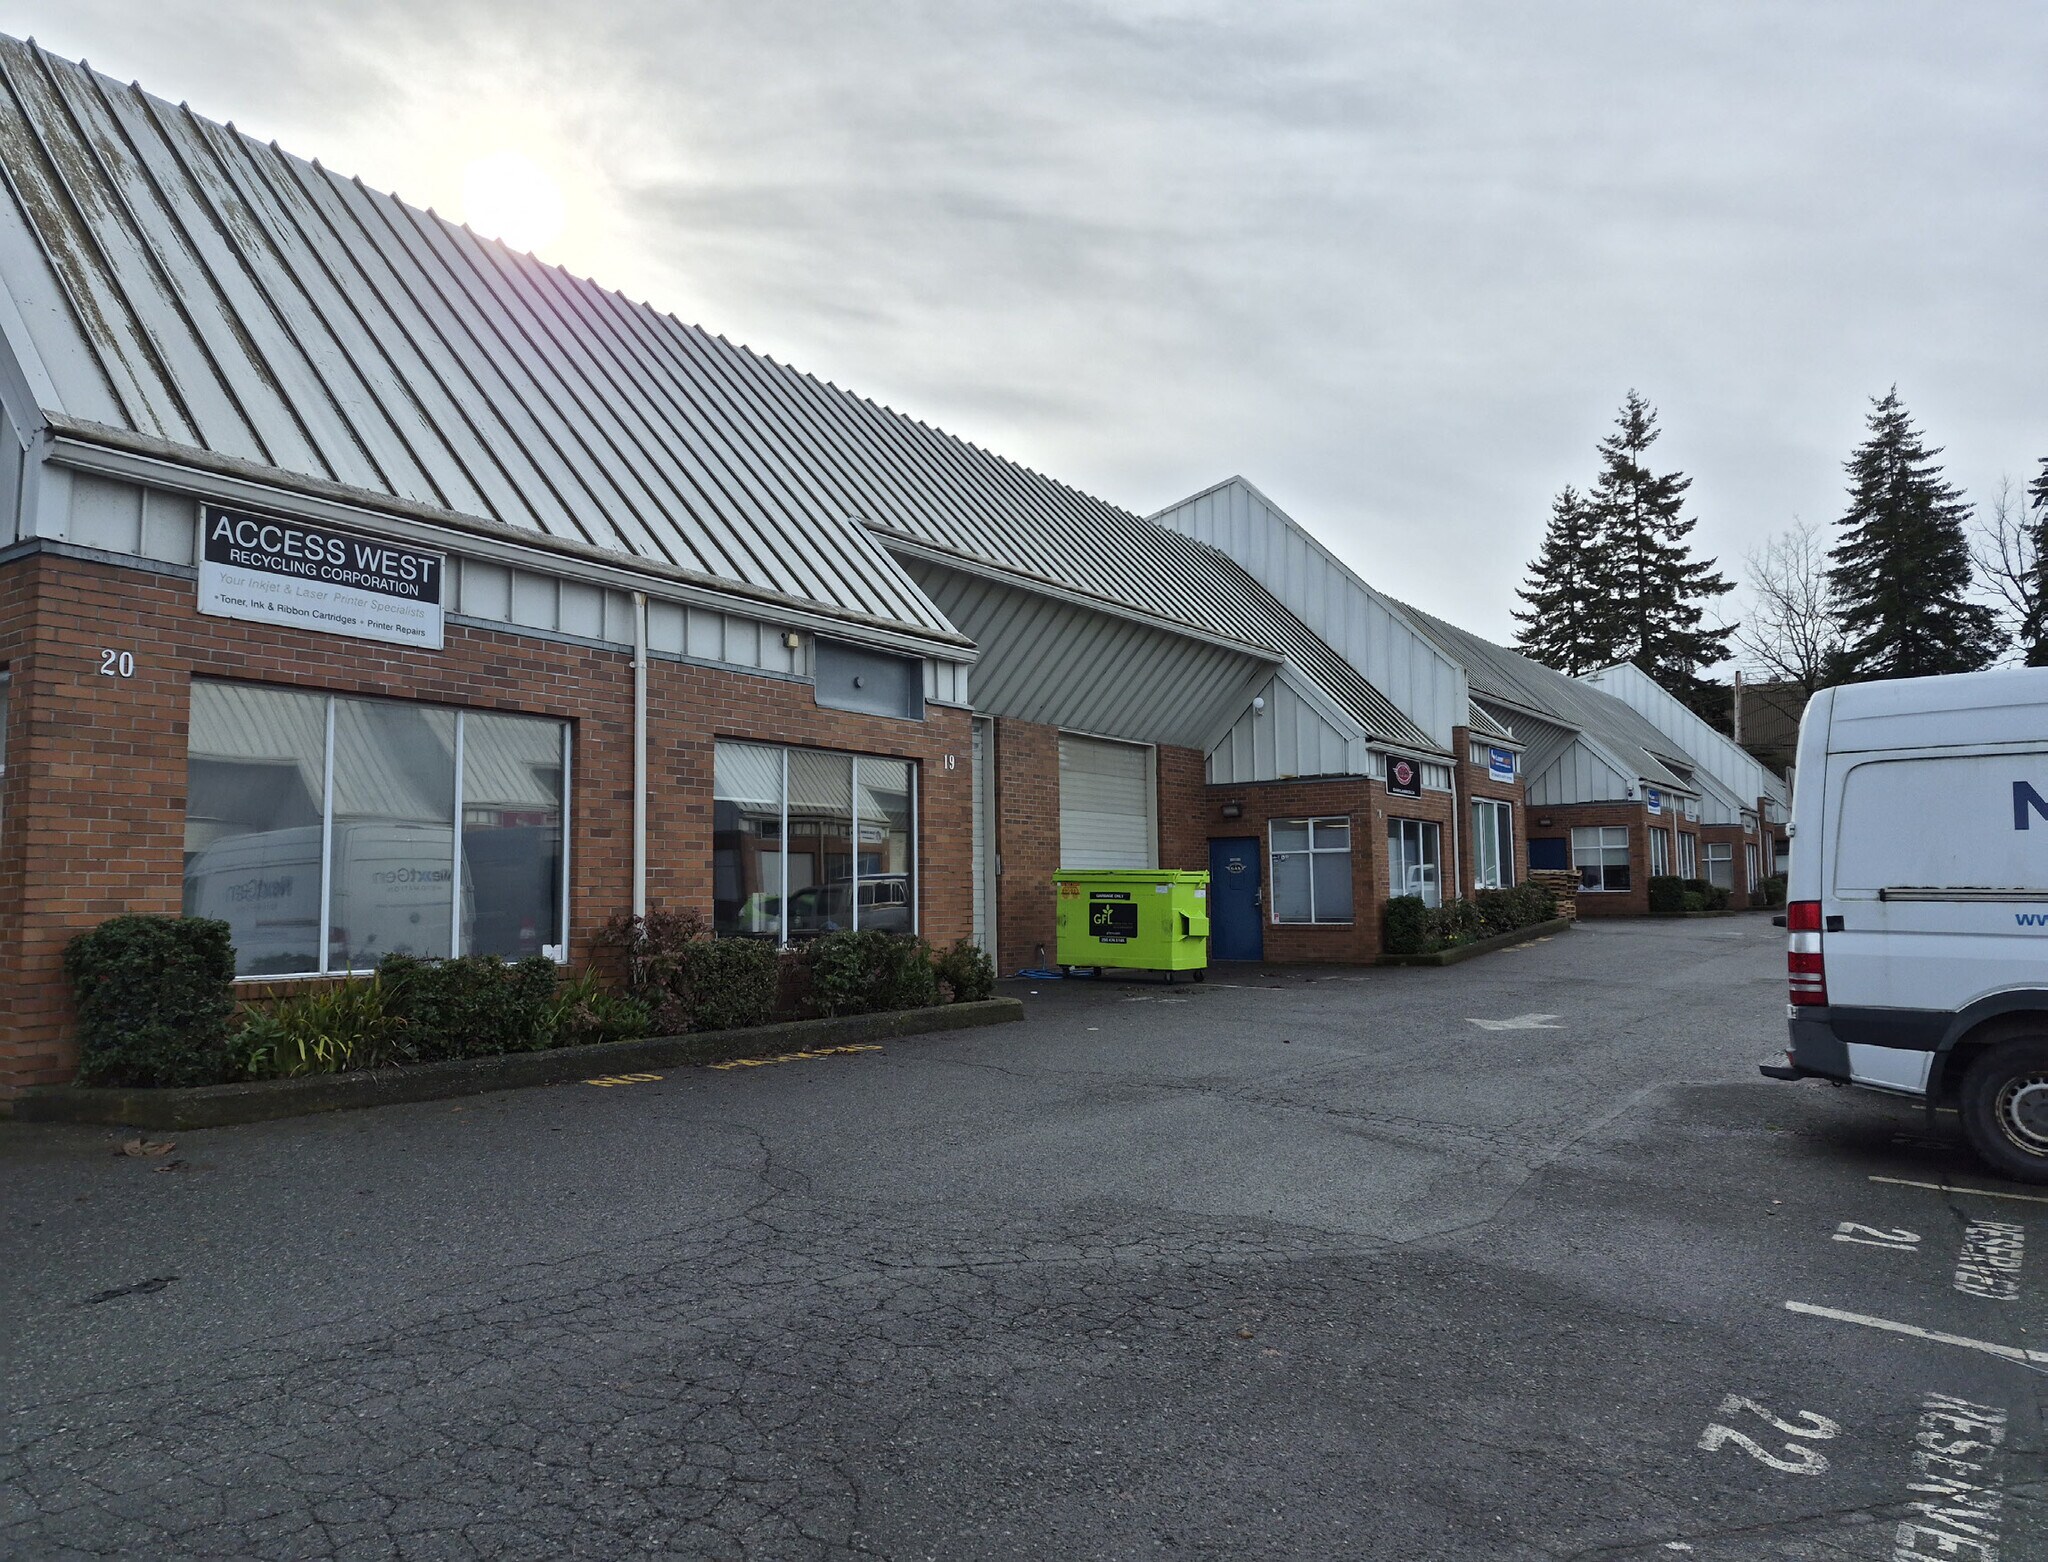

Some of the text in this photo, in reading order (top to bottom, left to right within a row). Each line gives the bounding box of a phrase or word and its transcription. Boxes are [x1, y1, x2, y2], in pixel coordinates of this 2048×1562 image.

[212, 515, 435, 583] ACCESS WEST
[230, 549, 419, 596] RECYCLING CORPORATION
[220, 572, 425, 619] Your Inkjet & Laser Printer Specialists
[250, 598, 265, 610] Ink
[267, 601, 275, 611] &
[277, 604, 310, 617] Ribbon
[312, 609, 357, 626] Cartridges
[367, 619, 394, 632] Printer
[396, 624, 426, 638] Repairs
[101, 649, 134, 677] 20
[944, 754, 955, 770] 19
[1093, 908, 1113, 925] GFL
[1831, 1221, 1922, 1251] 21
[1953, 1219, 2025, 1300] RESERVED
[1698, 1393, 1841, 1476] 22
[1893, 1391, 2008, 1562] RESERVE
